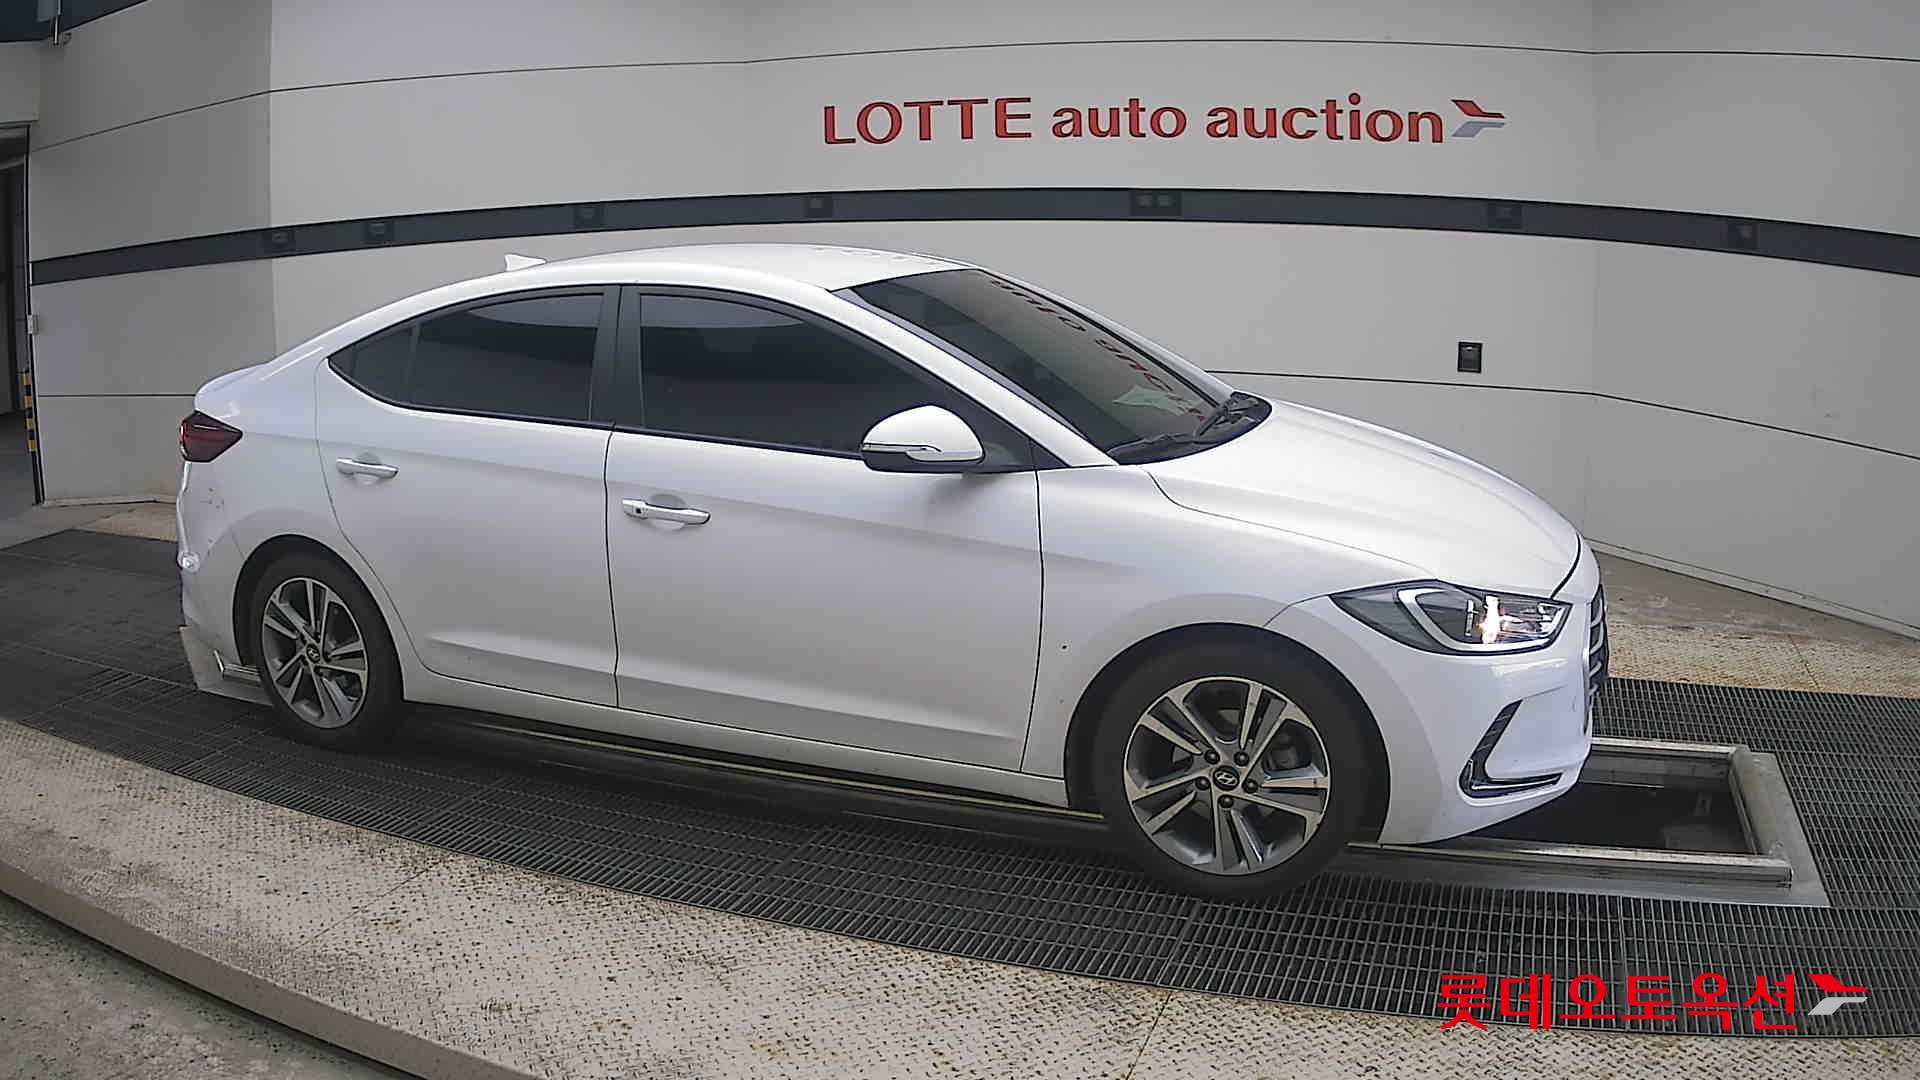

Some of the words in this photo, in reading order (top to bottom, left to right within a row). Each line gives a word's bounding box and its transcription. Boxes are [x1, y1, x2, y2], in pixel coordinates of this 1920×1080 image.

[823, 96, 1032, 146] LOTTE
[1051, 97, 1187, 139] auto
[1206, 92, 1445, 145] auction
